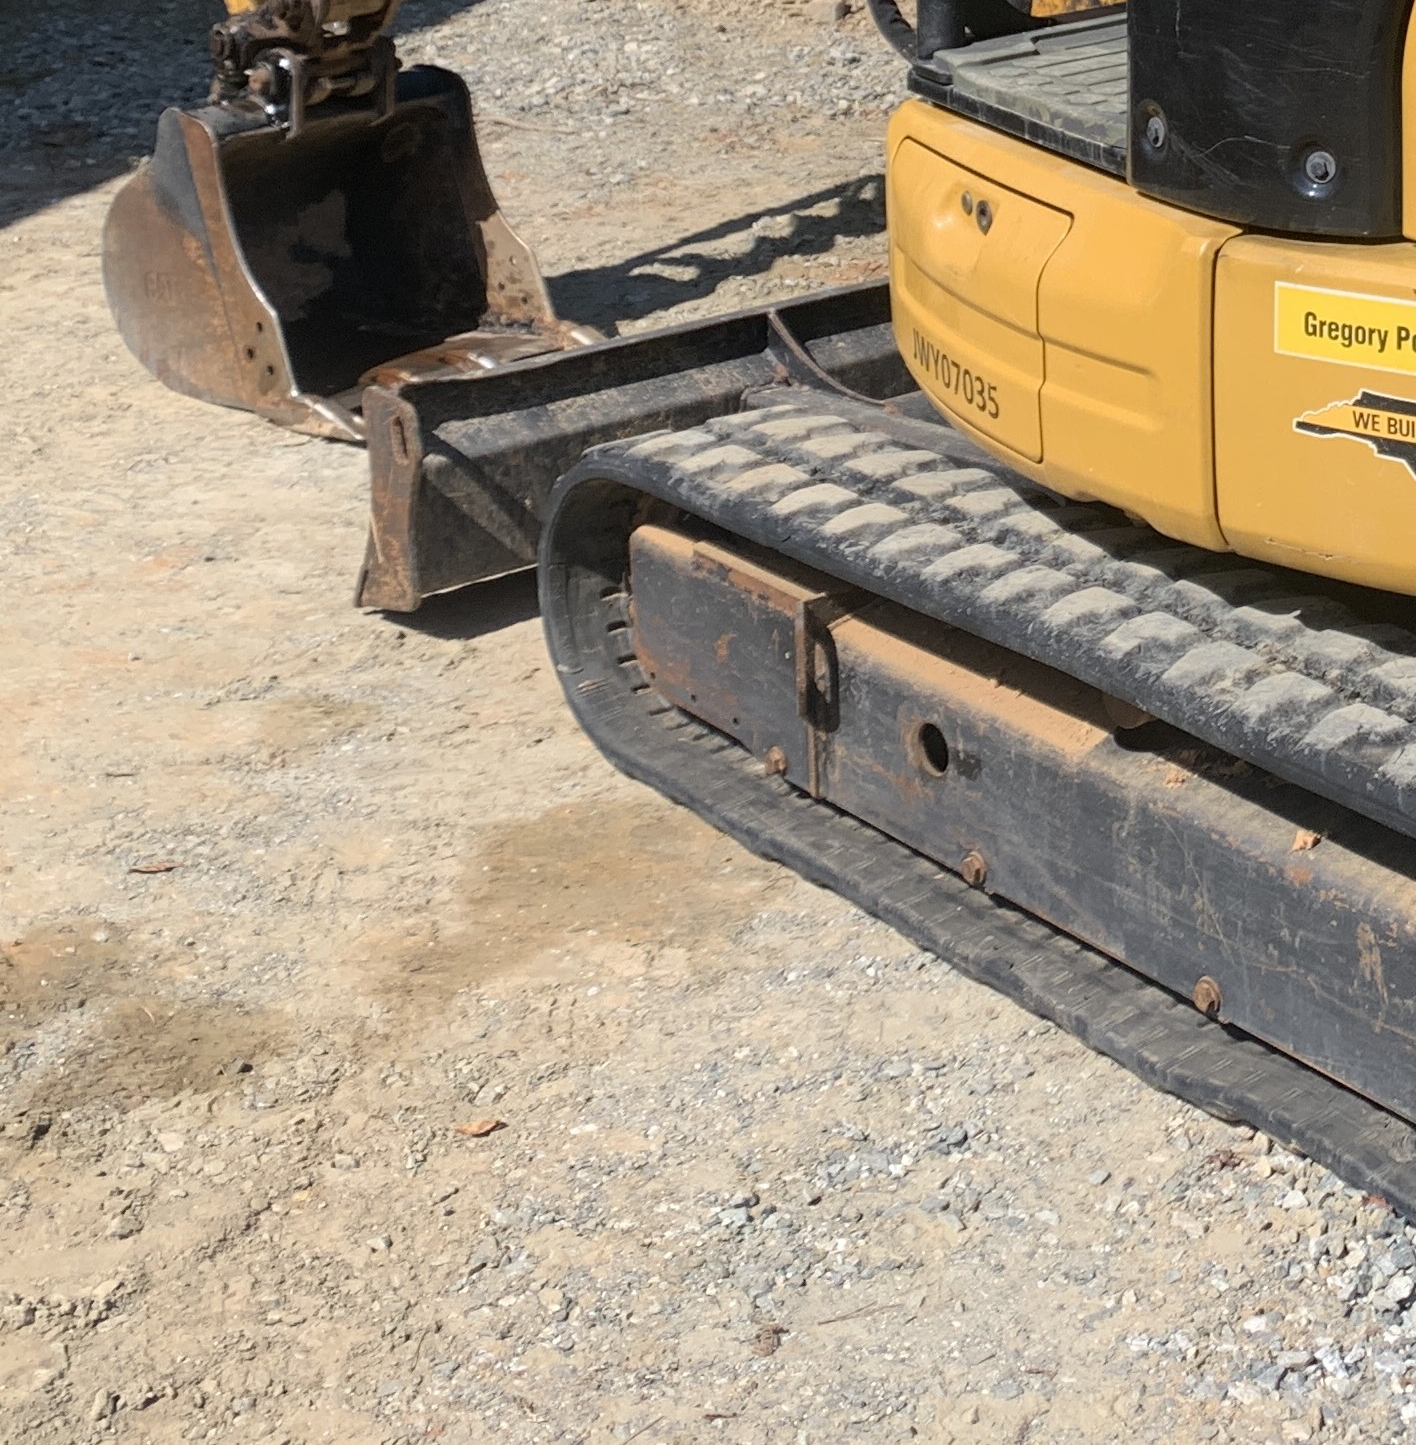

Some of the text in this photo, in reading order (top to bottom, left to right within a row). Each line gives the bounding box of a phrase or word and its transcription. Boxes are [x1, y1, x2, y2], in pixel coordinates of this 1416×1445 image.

[1304, 311, 1388, 353] Gregory
[913, 328, 999, 419] JWY07035
[1352, 410, 1381, 432] WE
